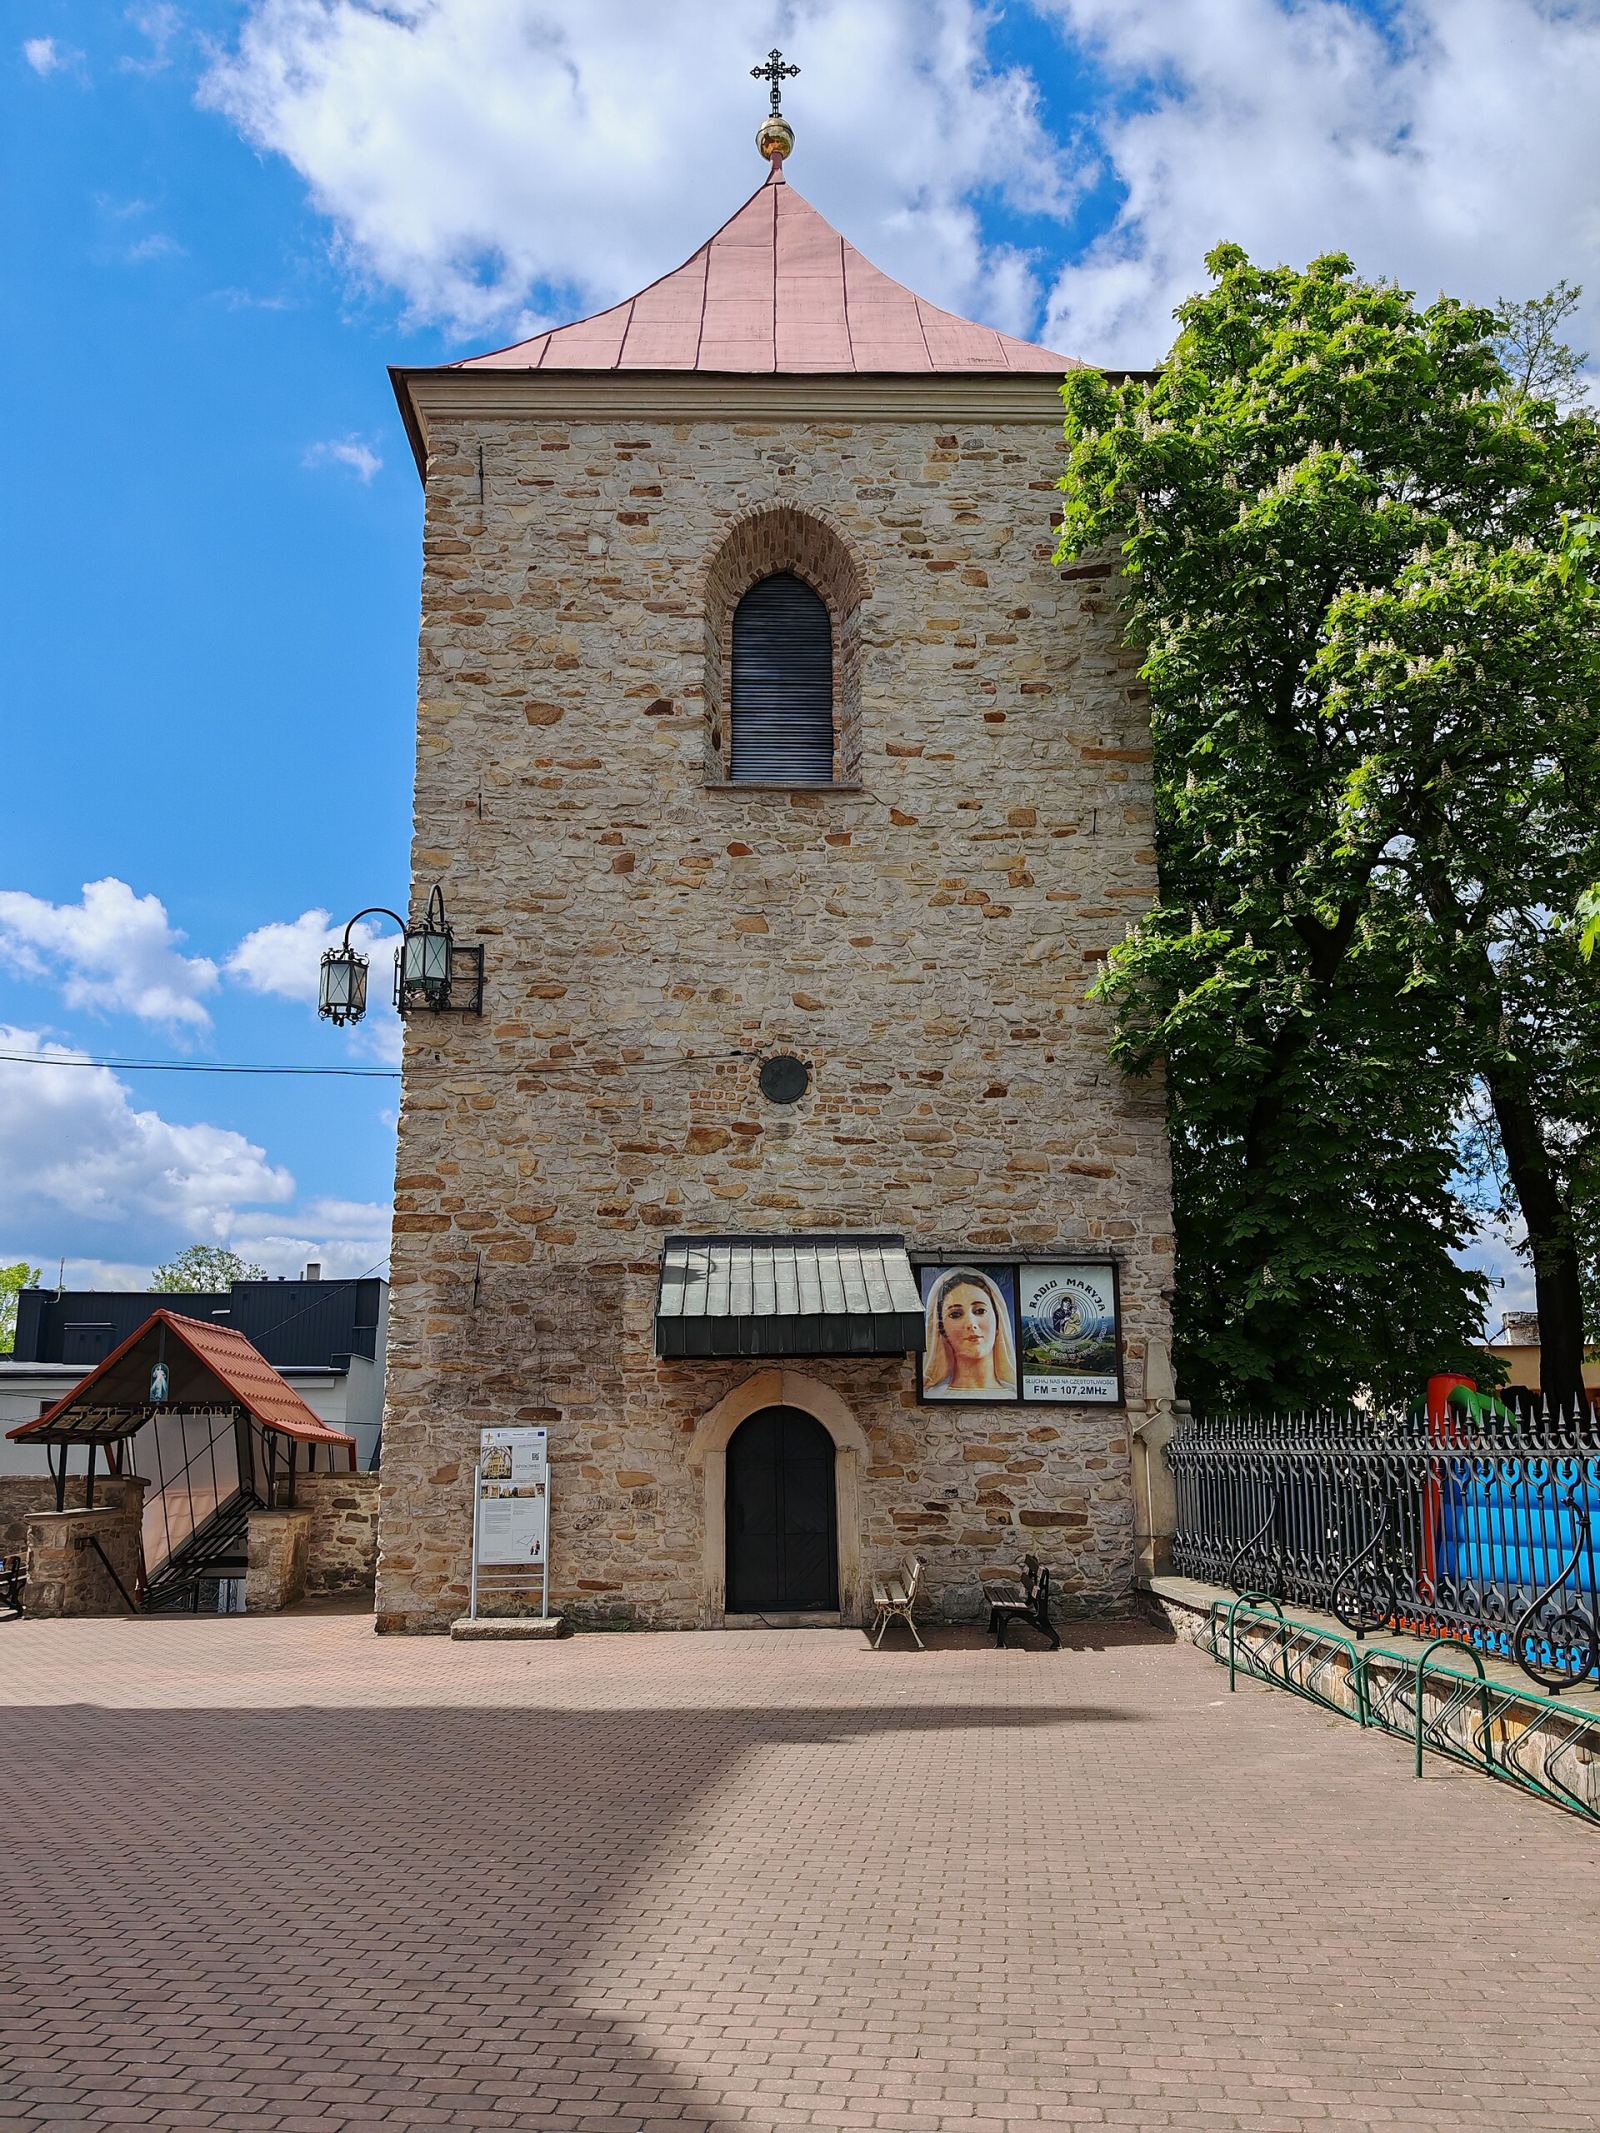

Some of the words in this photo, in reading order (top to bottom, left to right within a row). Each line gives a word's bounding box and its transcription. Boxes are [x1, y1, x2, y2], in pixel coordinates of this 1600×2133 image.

[1029, 1279, 1058, 1309] RADIO
[1066, 1278, 1106, 1312] MARYJA
[1033, 1385, 1049, 1394] FM
[1060, 1385, 1108, 1396] 107,2MHz
